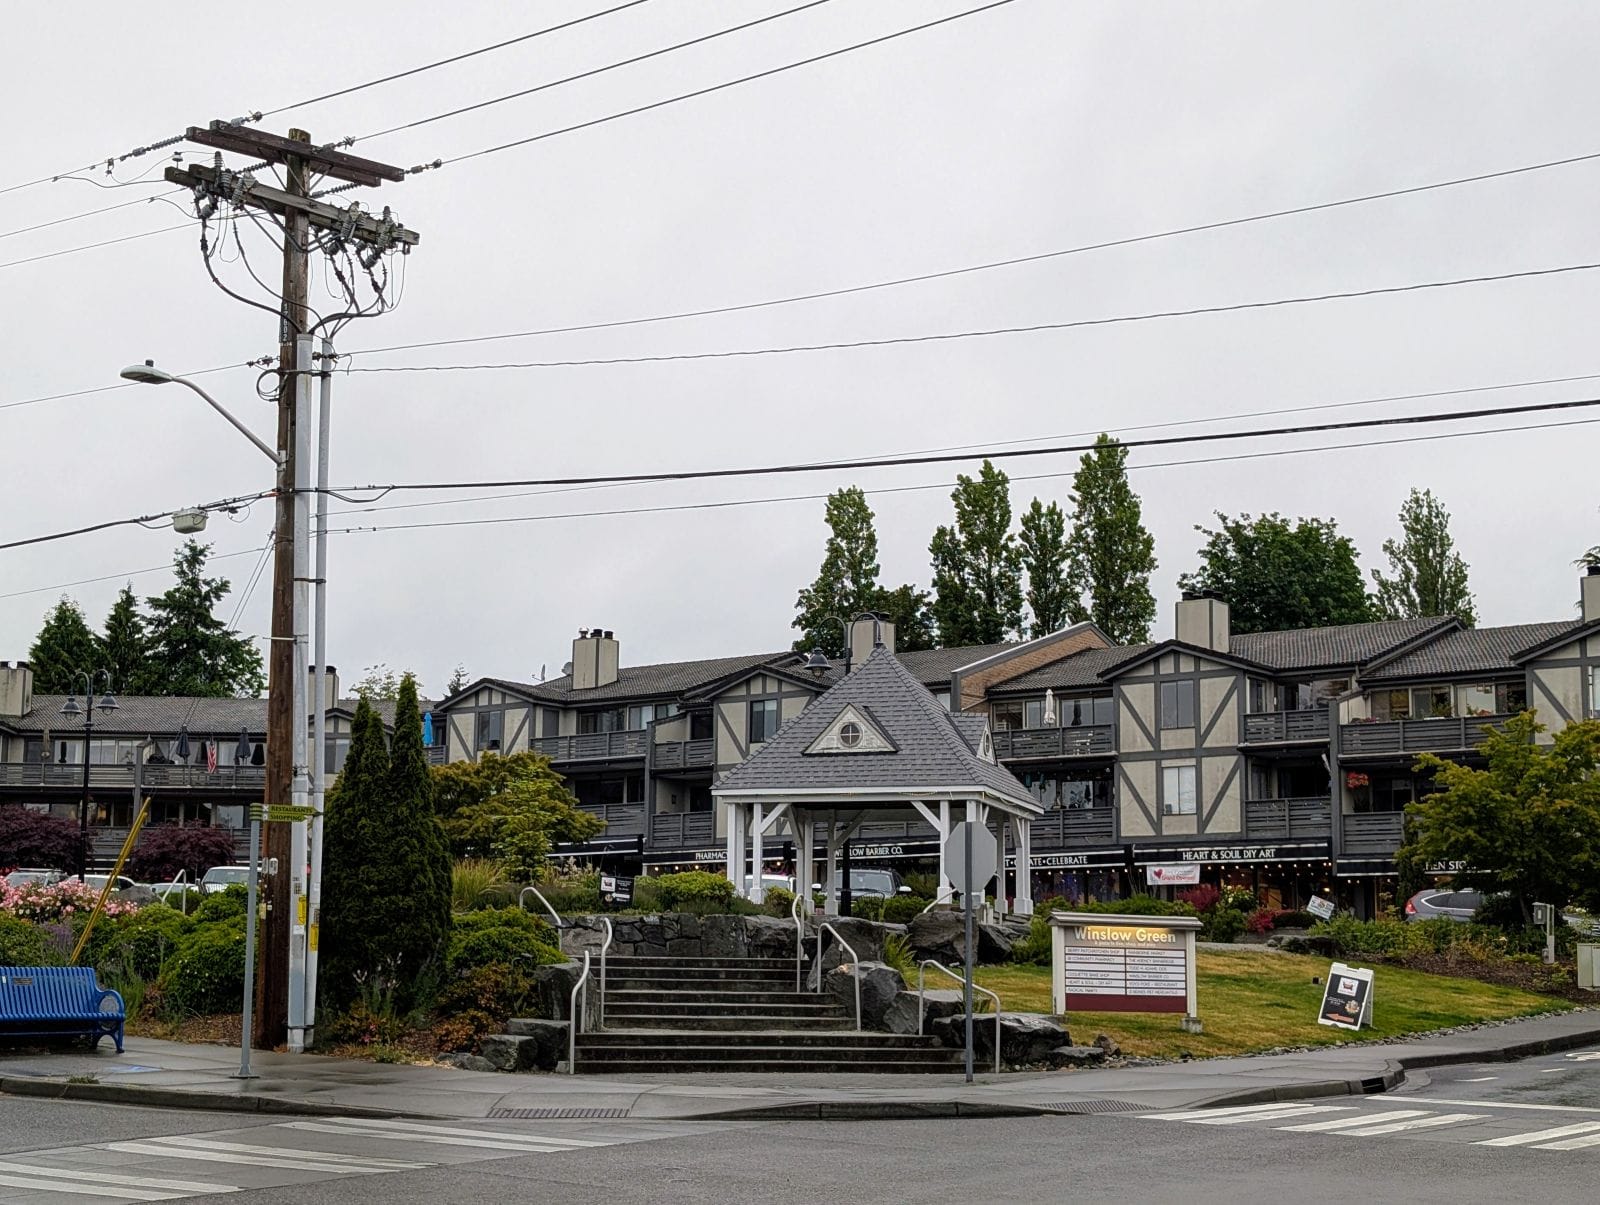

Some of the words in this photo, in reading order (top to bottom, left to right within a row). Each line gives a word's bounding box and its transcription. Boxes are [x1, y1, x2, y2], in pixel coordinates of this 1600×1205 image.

[865, 847, 890, 856] BARBER
[1182, 851, 1209, 861] HEART
[1211, 851, 1218, 860] &
[1220, 850, 1242, 860] SOUL
[1243, 849, 1257, 859] DIY
[1258, 848, 1276, 858] ART
[1074, 926, 1132, 941] Winslow
[1135, 927, 1176, 943] Green
